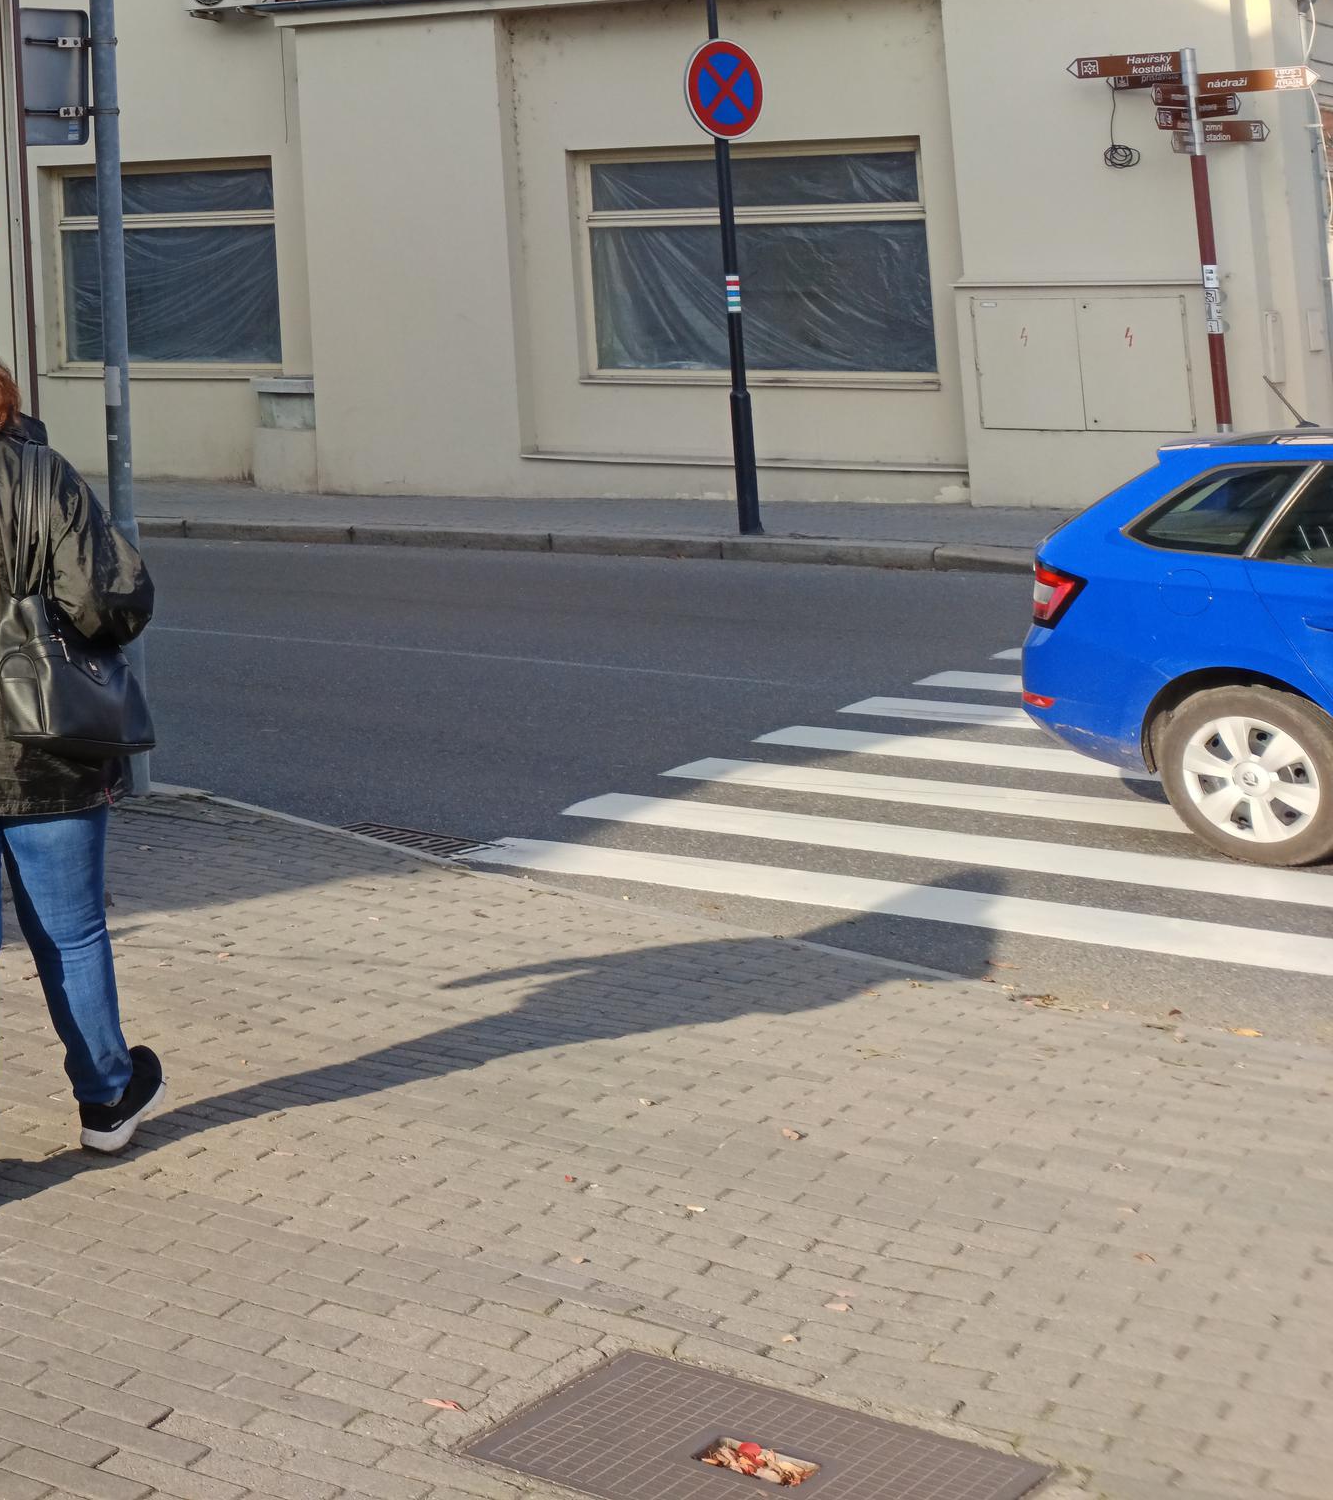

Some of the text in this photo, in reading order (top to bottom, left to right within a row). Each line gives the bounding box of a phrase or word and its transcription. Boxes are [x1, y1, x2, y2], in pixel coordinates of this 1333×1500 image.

[1126, 53, 1172, 65] Havířský
[1132, 64, 1173, 74] kostelík
[1207, 77, 1248, 88] nádraží
[1205, 122, 1223, 131] zimní
[1205, 132, 1231, 141] stadion
